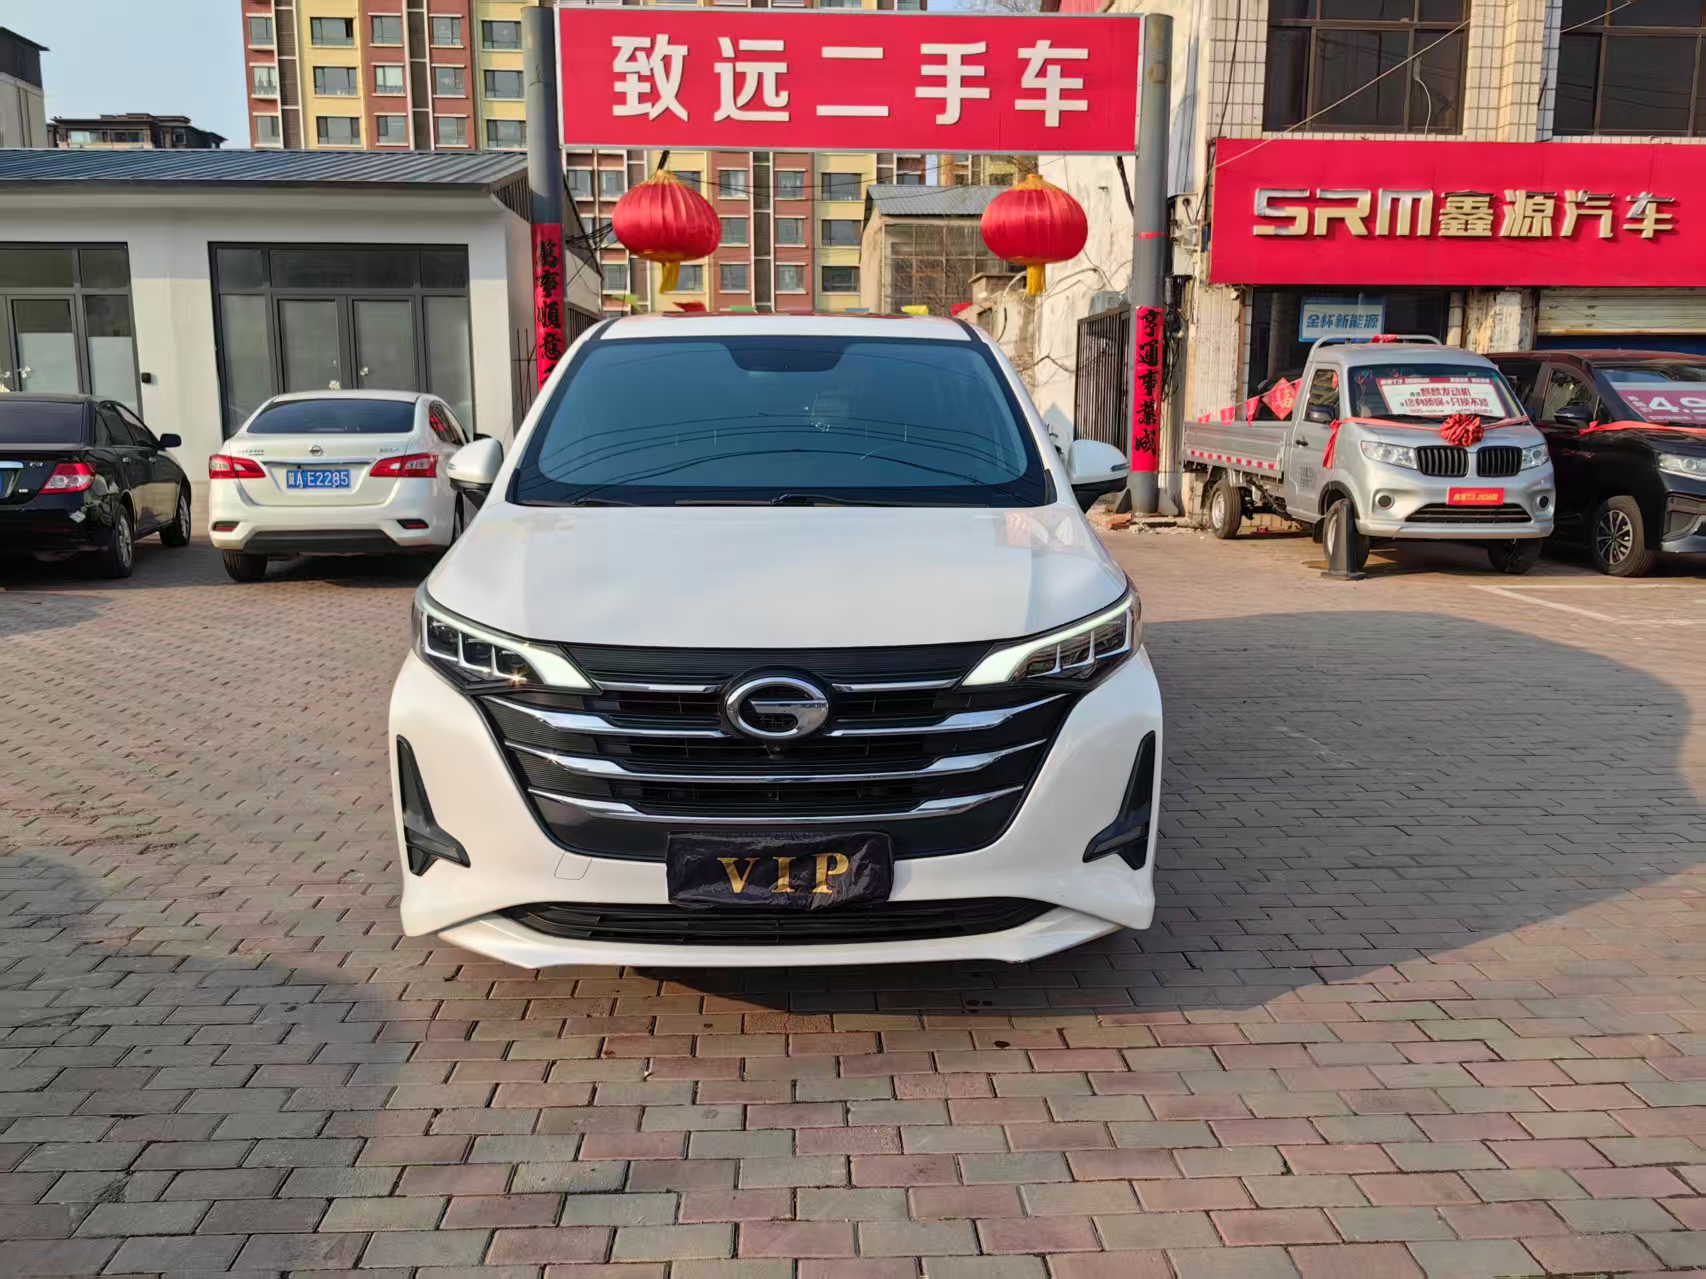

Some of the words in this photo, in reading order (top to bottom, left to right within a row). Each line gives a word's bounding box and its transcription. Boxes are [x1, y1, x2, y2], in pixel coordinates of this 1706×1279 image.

[611, 33, 1089, 128] 致远二手车
[1305, 312, 1380, 329] 金杯新能源
[717, 852, 851, 895] VIP
